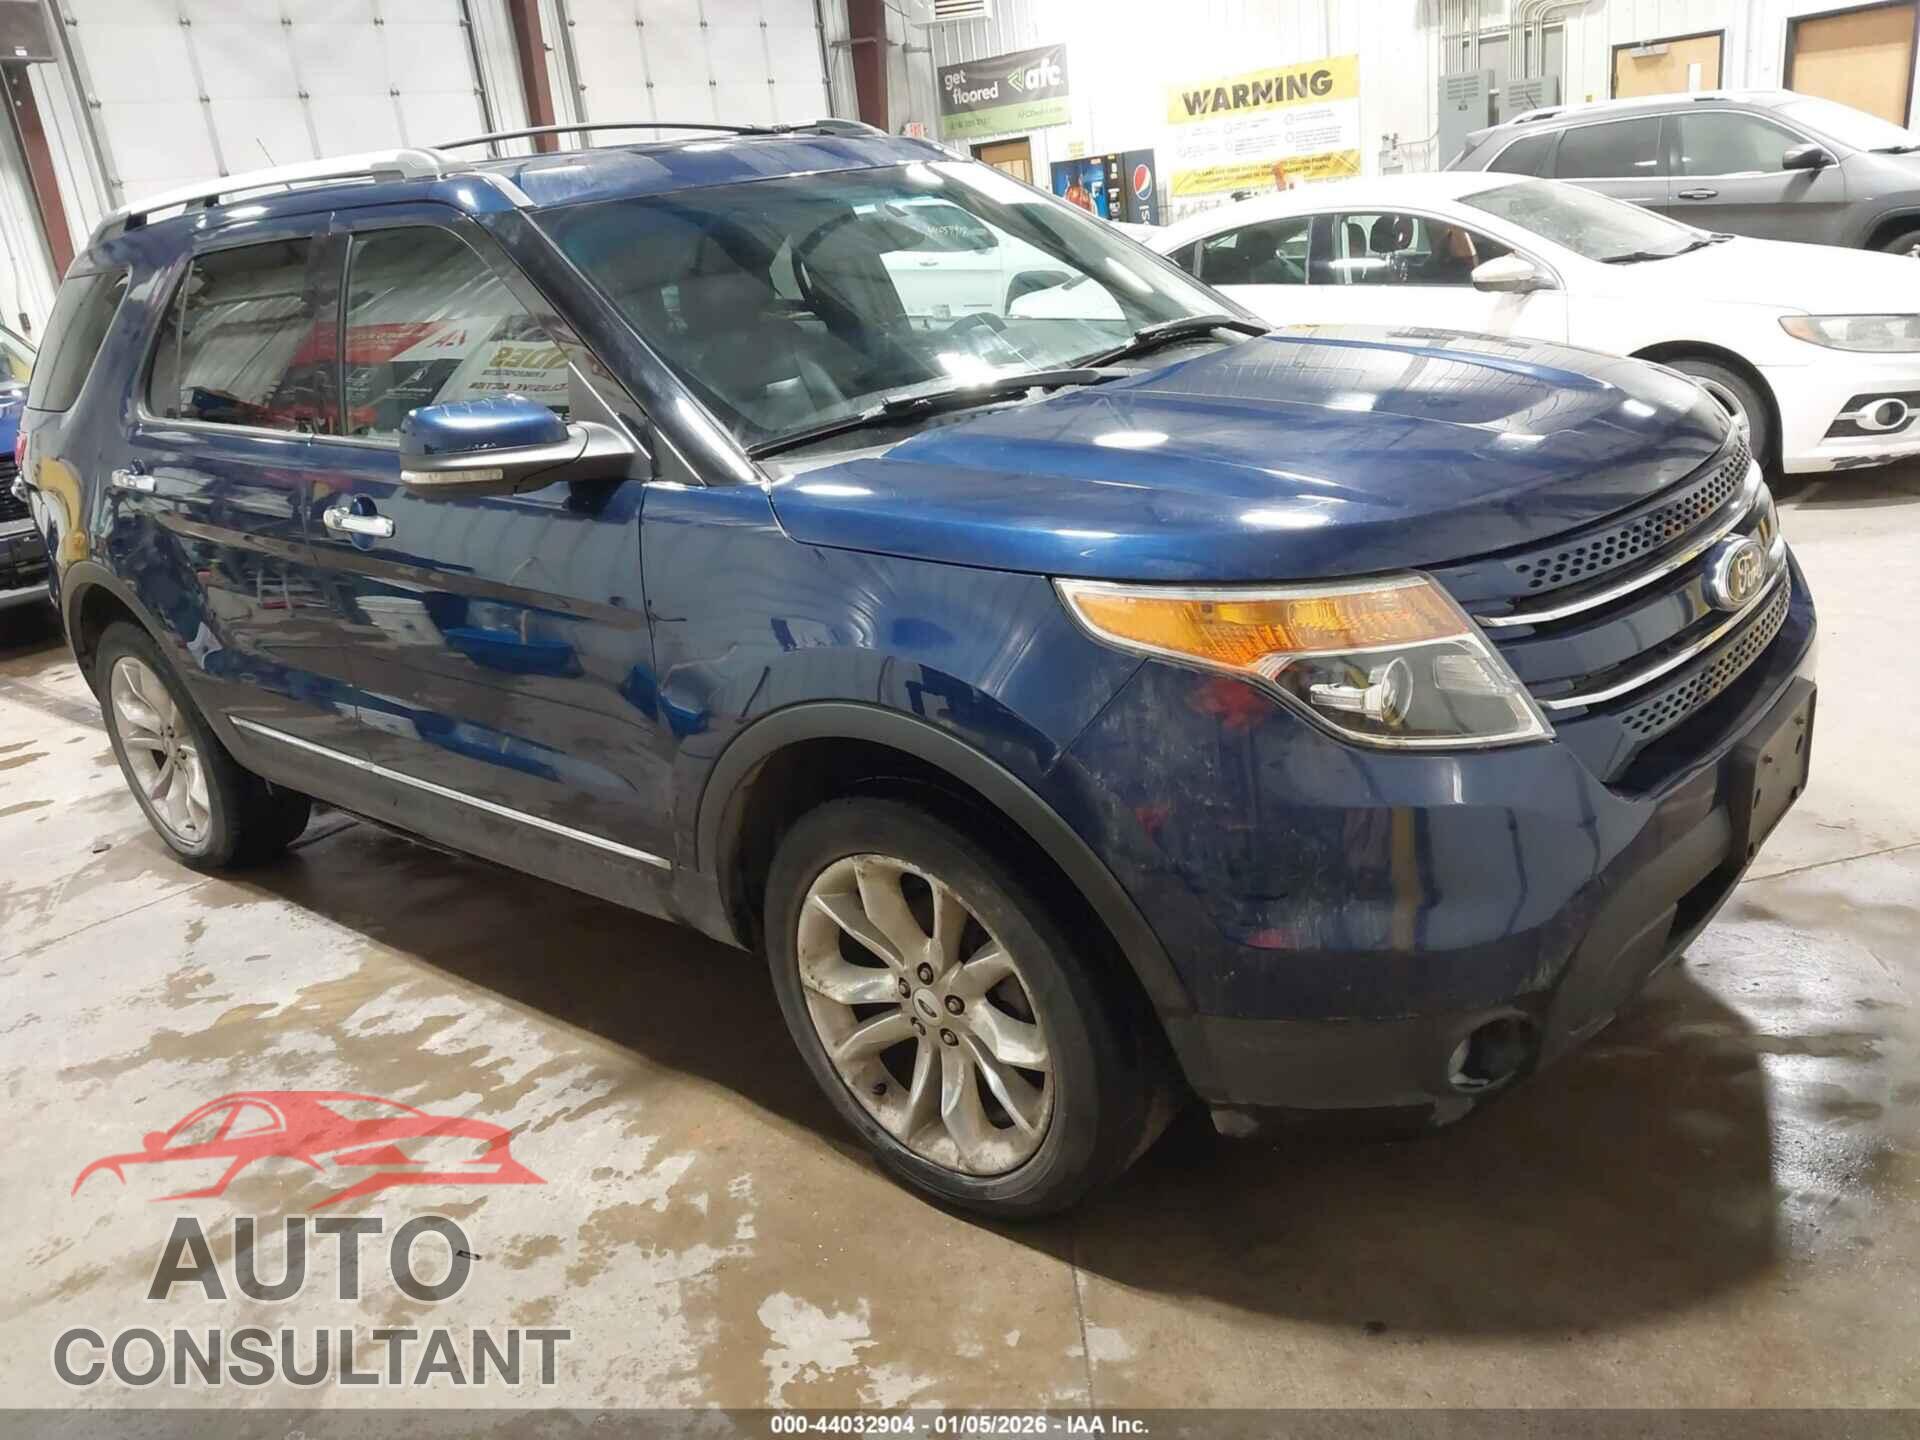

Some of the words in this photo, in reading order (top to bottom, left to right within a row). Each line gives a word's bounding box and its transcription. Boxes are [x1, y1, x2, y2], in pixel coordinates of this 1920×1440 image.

[944, 69, 966, 91] get
[952, 81, 999, 105] floored
[1182, 69, 1334, 117] WARNING
